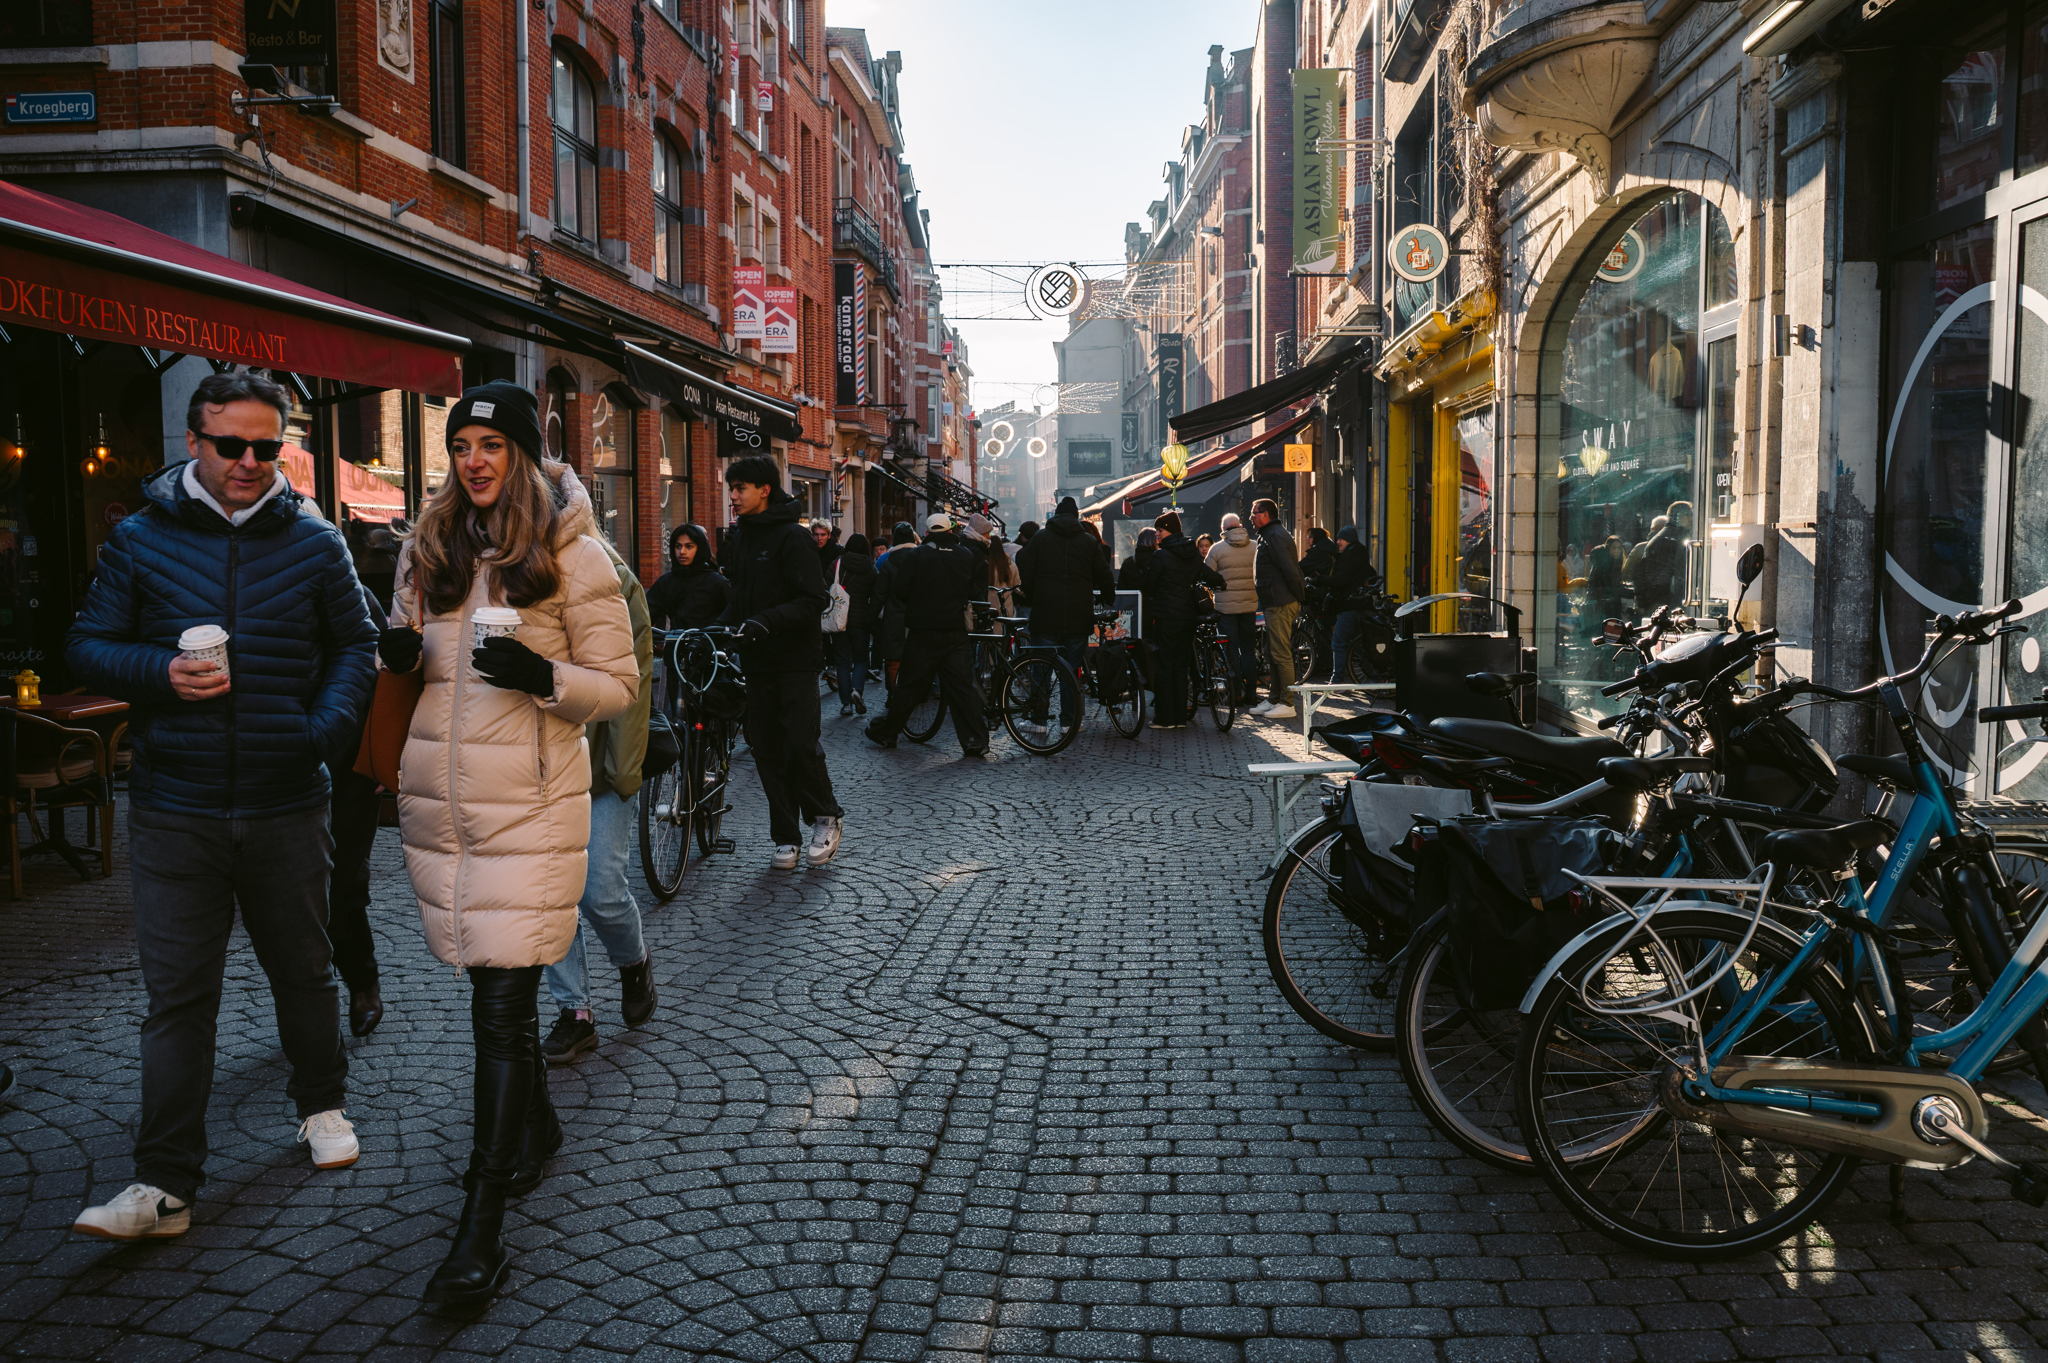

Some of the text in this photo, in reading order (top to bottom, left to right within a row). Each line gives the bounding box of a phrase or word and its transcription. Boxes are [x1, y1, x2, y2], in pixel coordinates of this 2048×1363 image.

[249, 31, 322, 46] Resto & Bar
[20, 100, 89, 117] Kroegberg
[1304, 87, 1321, 236] ASIAN BOWL
[1321, 99, 1336, 218] Vietnames Kitchen
[734, 271, 762, 279] OPEN
[144, 306, 287, 362] RESTAURANT
[766, 327, 789, 336] ERA
[841, 296, 854, 373] kameraad
[1160, 338, 1182, 348] Resto
[1163, 358, 1180, 419] Ribs
[683, 384, 701, 405] OONA
[716, 396, 728, 415] Asian
[728, 401, 749, 423] Restaurant
[1582, 420, 1631, 453] SWAY
[1610, 461, 1620, 471] AND
[1620, 458, 1640, 471] SQUARE
[1716, 472, 1731, 487] OPEN
